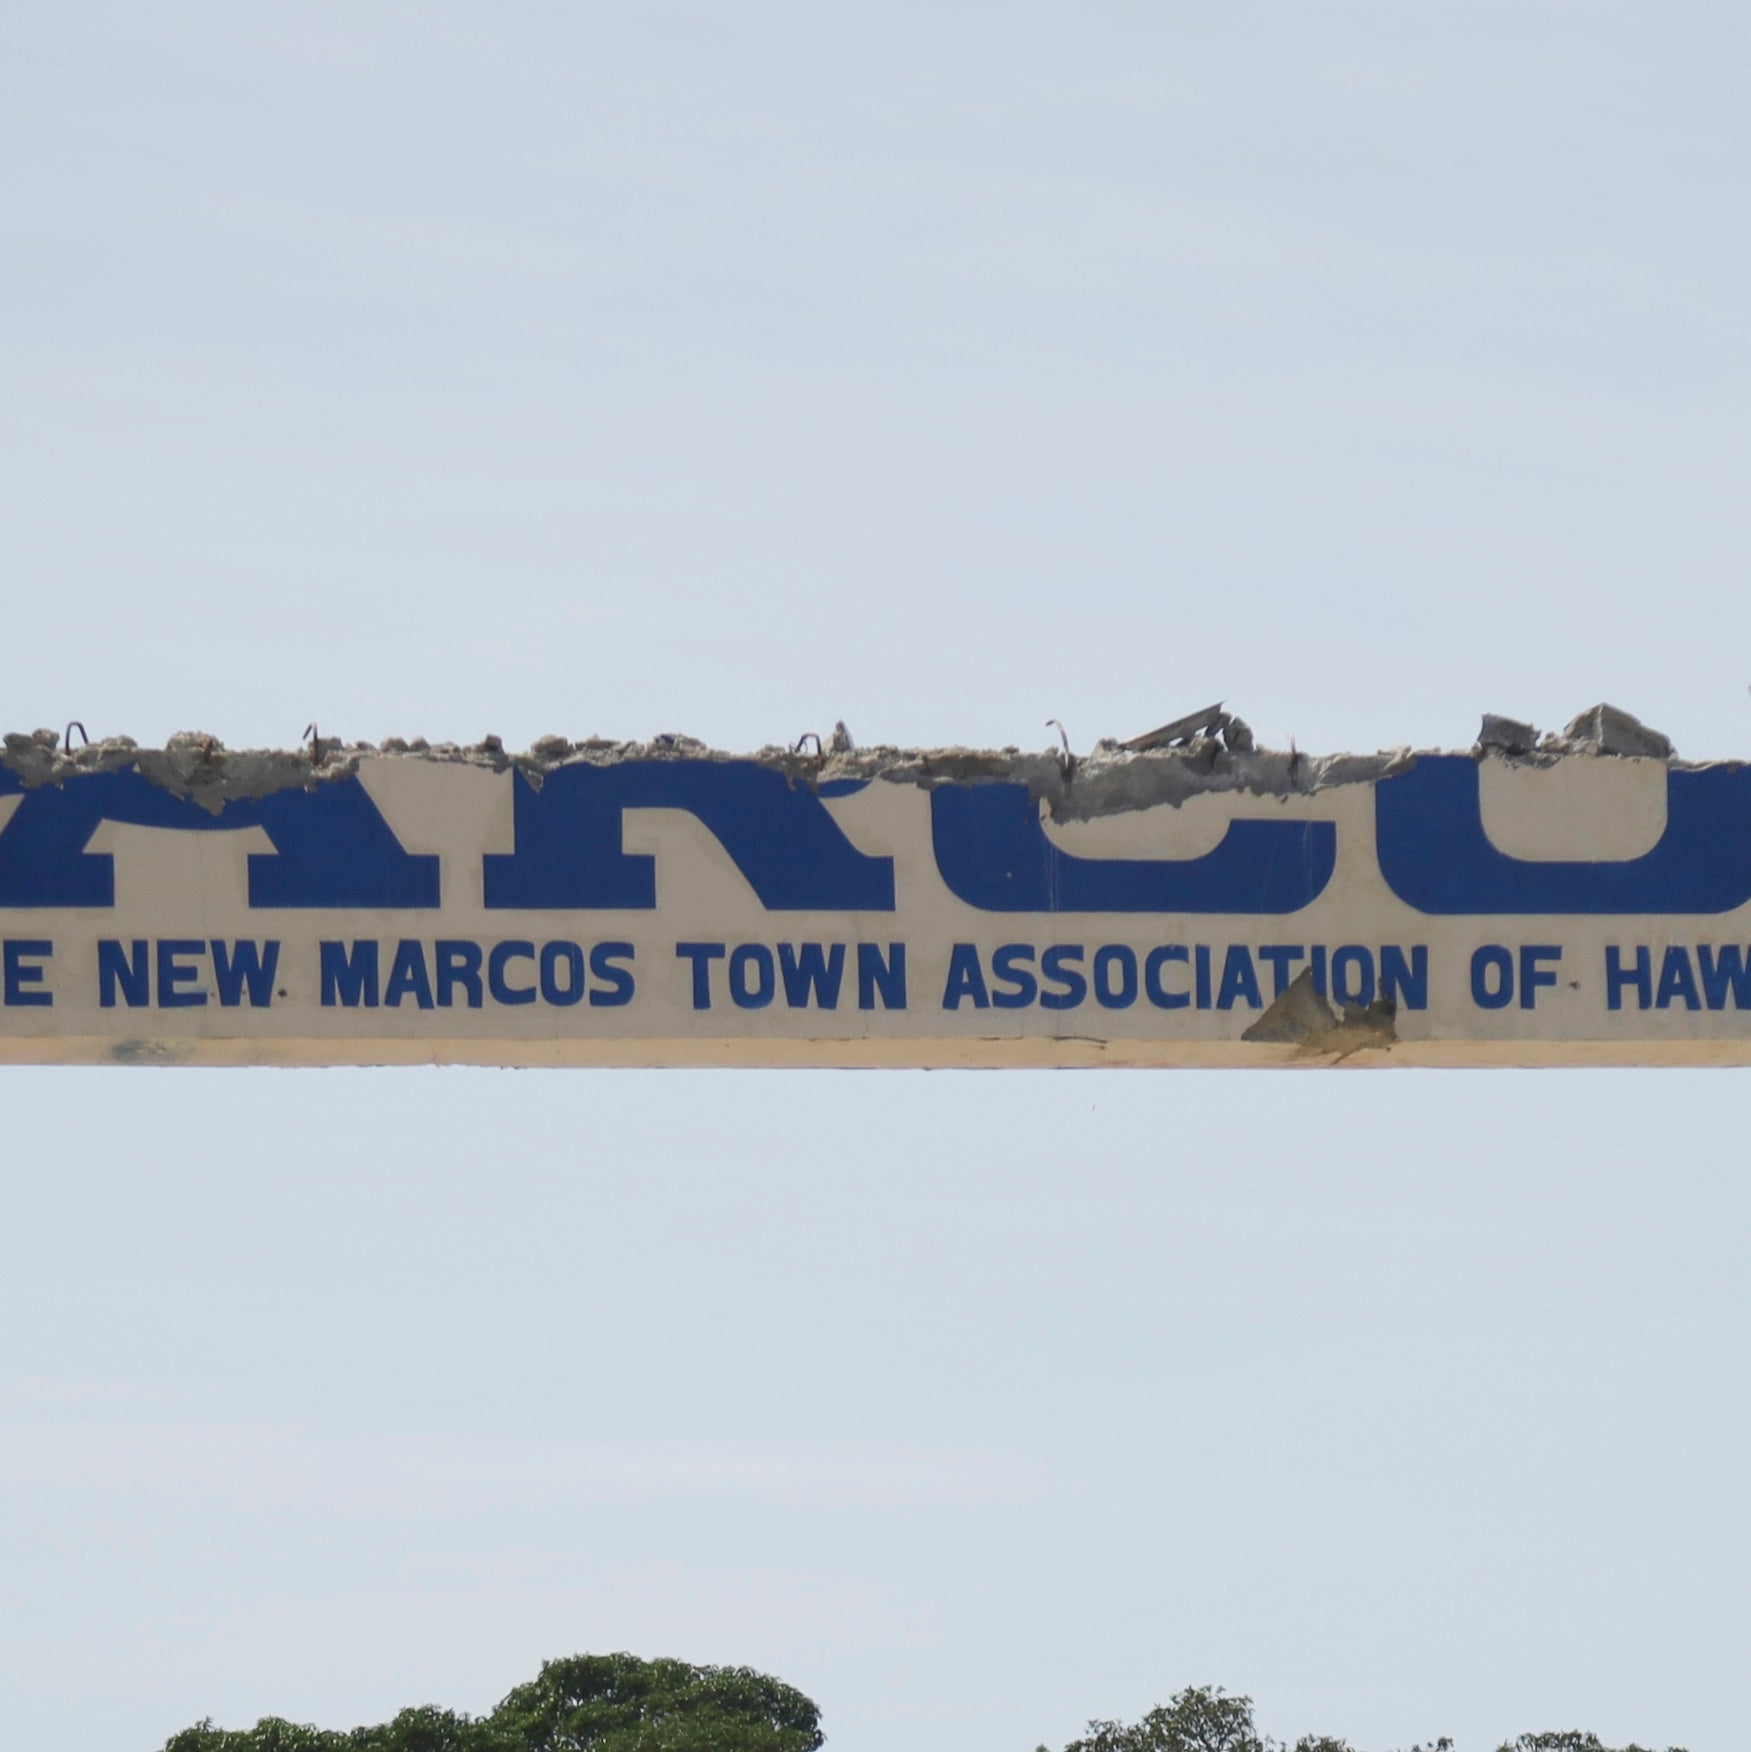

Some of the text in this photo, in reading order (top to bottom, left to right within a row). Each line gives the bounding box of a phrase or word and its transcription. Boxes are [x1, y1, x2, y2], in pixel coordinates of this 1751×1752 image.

[99, 940, 279, 1006] NEW
[321, 940, 634, 1008] MARCOS
[676, 942, 906, 1009] TOWN
[943, 944, 1428, 1009] ASSOCIATION
[1470, 945, 1561, 1009] OF
